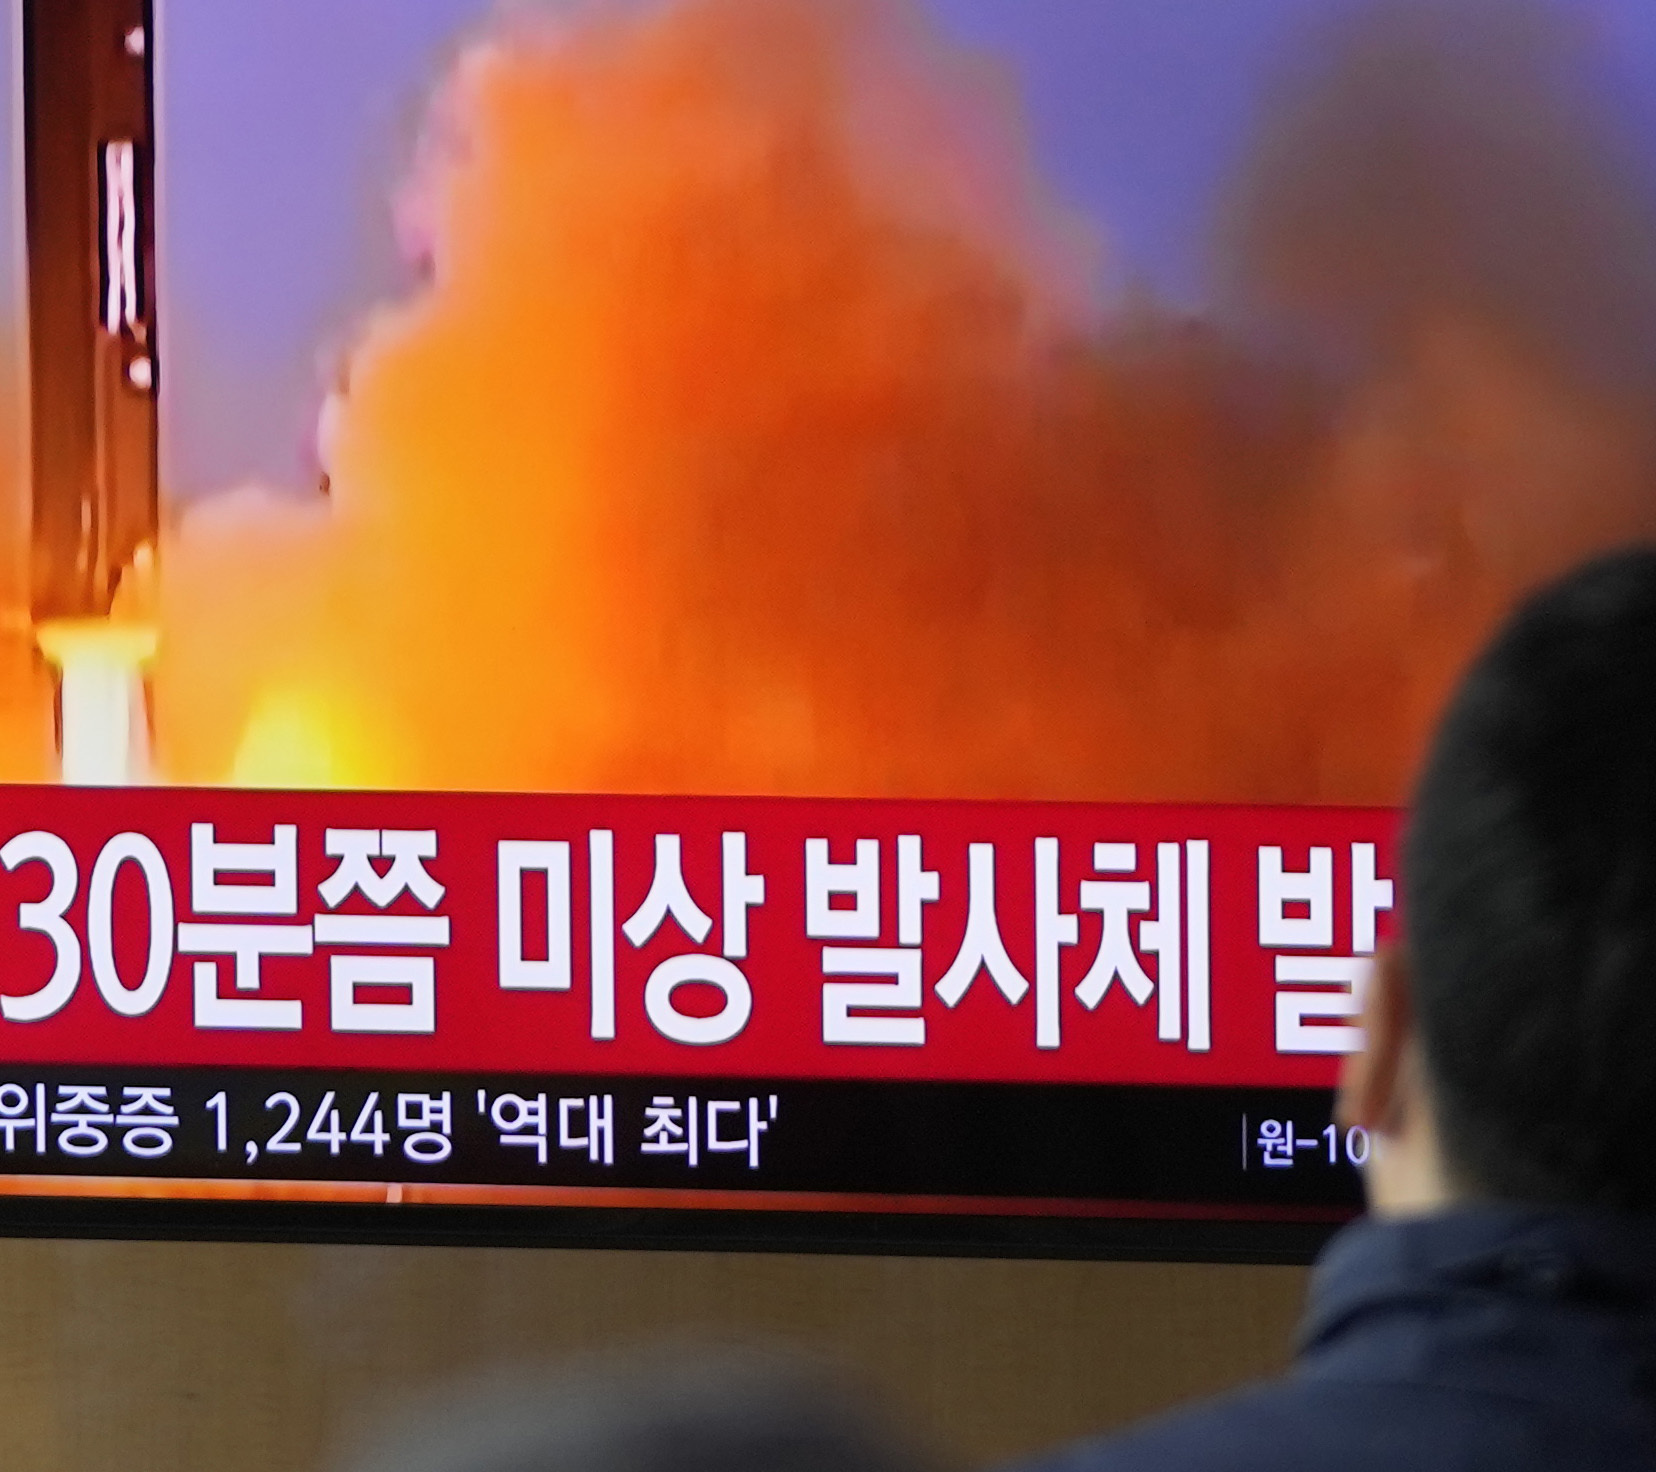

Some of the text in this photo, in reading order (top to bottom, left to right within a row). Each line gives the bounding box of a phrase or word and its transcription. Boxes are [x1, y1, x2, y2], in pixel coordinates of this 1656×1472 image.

[496, 828, 766, 1046] 미상
[804, 834, 1212, 1052] 발사체
[205, 1089, 454, 1166] 1,244명
[477, 1090, 614, 1166] '역대
[638, 1093, 780, 1172] 최다'
[1256, 1118, 1385, 1167] 원-10
